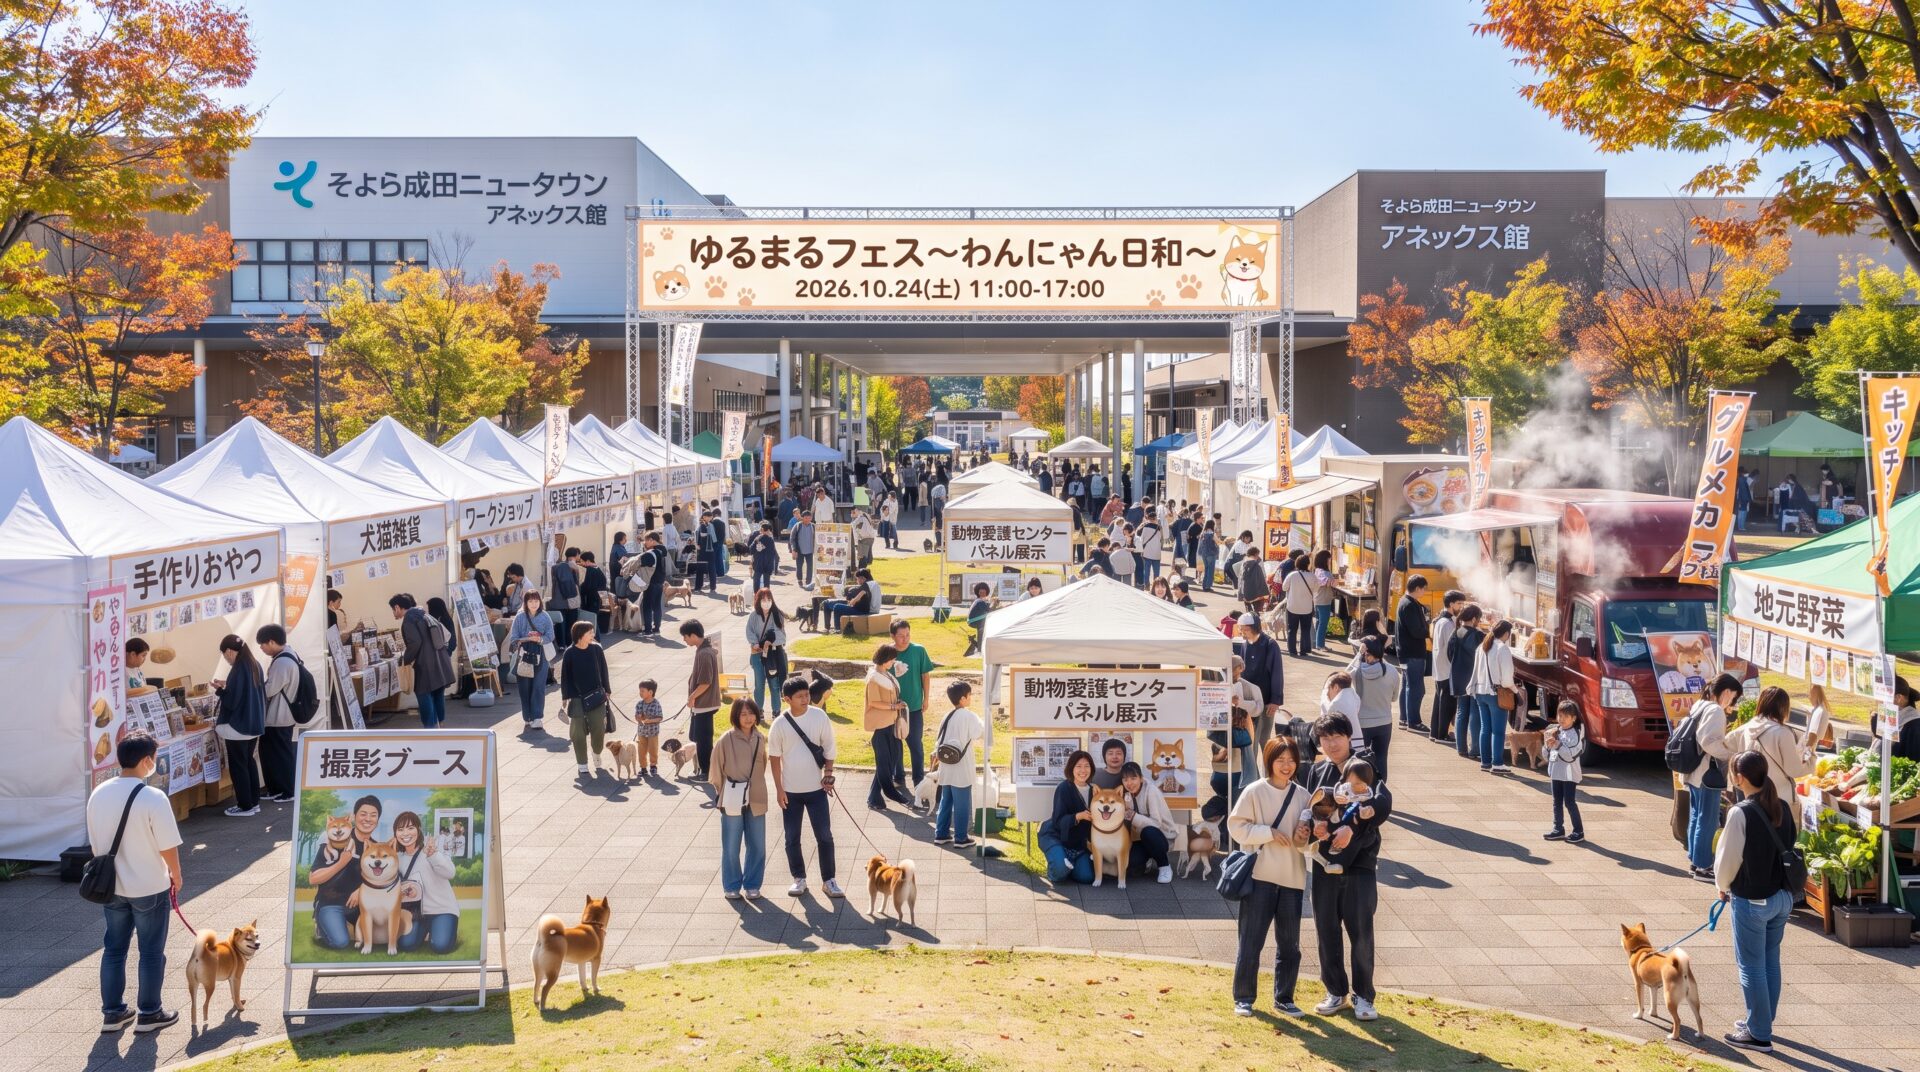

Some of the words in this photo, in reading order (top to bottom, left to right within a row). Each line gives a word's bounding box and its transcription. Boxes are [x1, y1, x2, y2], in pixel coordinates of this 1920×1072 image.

[328, 170, 608, 199] そよら成田ニュータウン
[486, 204, 607, 226] アネックス館
[1380, 199, 1536, 214] そよら成田ニュータウン
[1381, 224, 1530, 250] アネックス館
[795, 279, 961, 301] 2026.10.24(土)
[969, 279, 1105, 299] 11:00-17:00
[549, 481, 629, 514] 保護活動団体ブース
[466, 494, 534, 529] ワークショップ
[360, 515, 421, 555] 犬猫雑貨
[951, 525, 1068, 541] 動物愛護センター
[133, 548, 262, 600] 手作りおやつ
[1754, 584, 1846, 640] 地元野菜
[1024, 678, 1186, 699] 動物愛護センター
[1054, 703, 1157, 723] パネル展示
[320, 747, 470, 779] 撮影ブース
